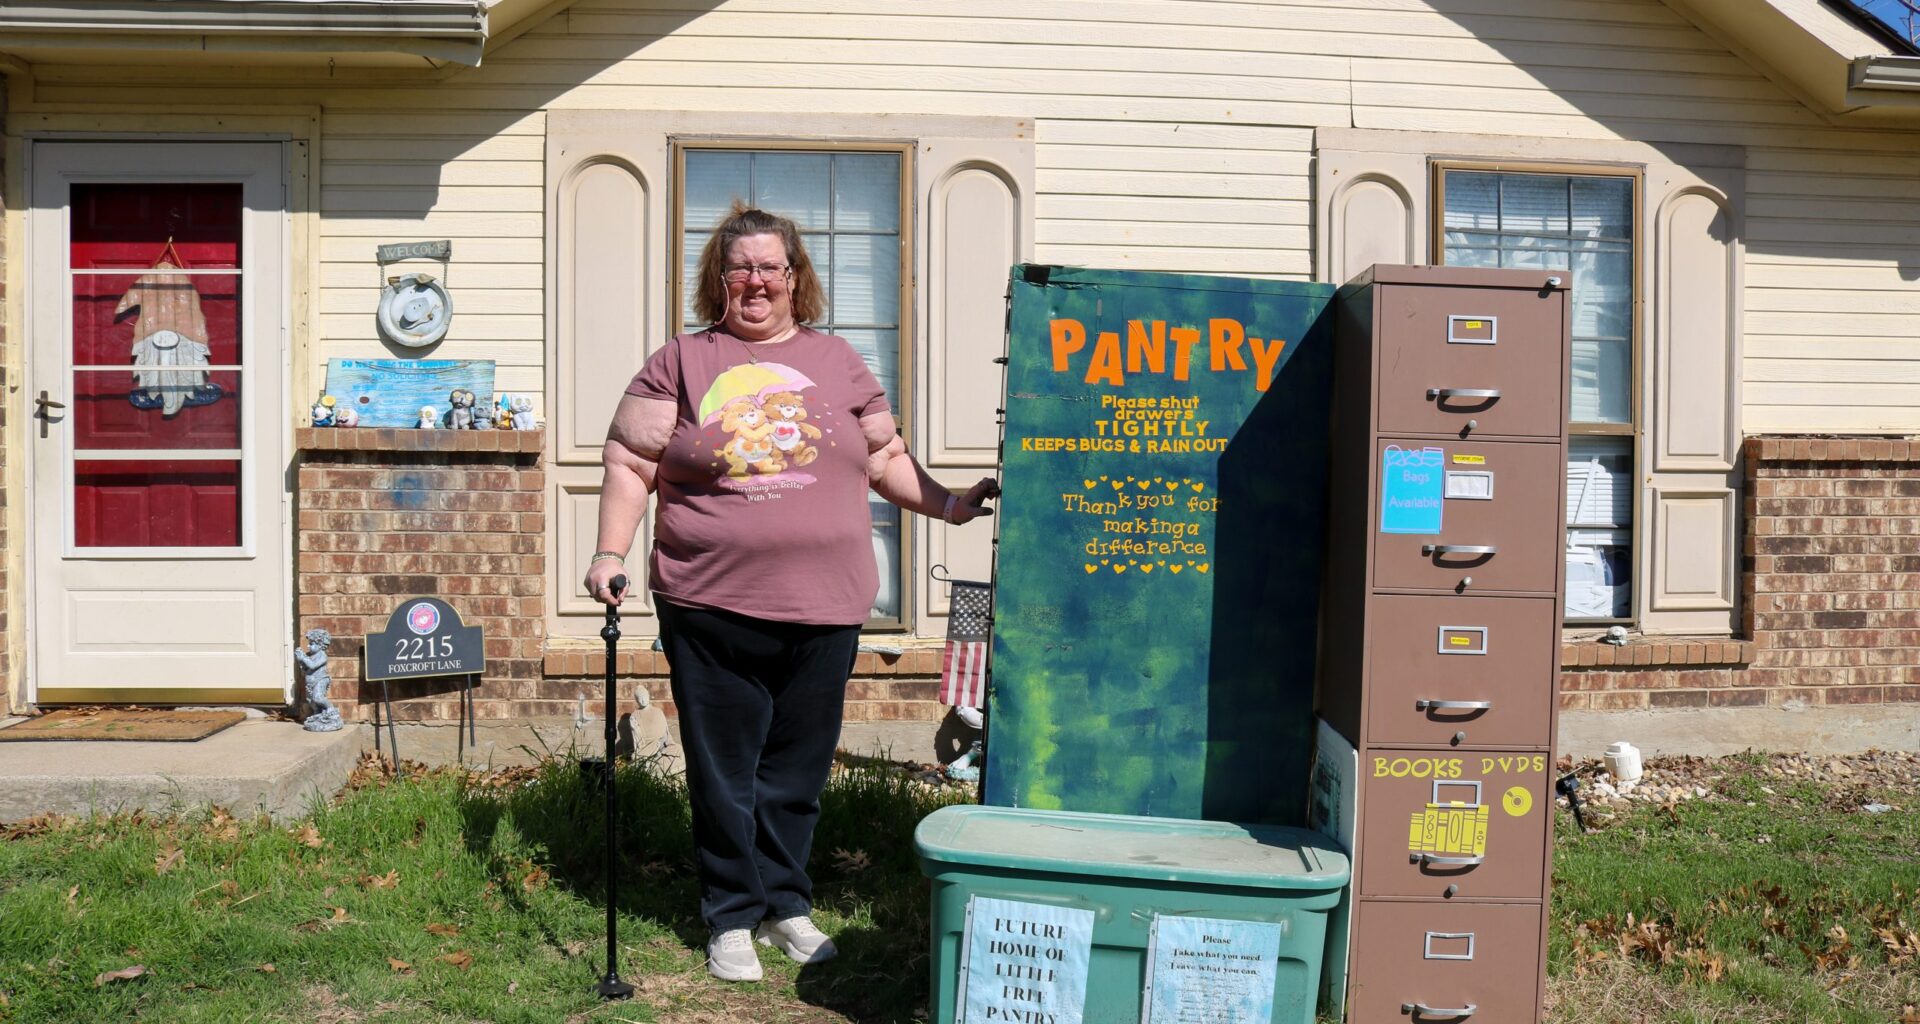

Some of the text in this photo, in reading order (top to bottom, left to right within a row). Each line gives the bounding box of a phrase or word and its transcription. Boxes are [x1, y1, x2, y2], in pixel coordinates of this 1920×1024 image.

[383, 243, 445, 258] WELCOME
[1050, 318, 1286, 393] PANTRY
[1101, 394, 1200, 409] Please shut
[1115, 404, 1195, 420] drawers
[1095, 420, 1209, 436] TIGHTLY
[1022, 438, 1228, 454] KEEPS BUGS & RAIN OUT
[780, 480, 804, 490] Better
[1402, 470, 1430, 485] Bags
[747, 492, 782, 502] With You
[1063, 492, 1222, 515] Thank you for
[1388, 496, 1439, 508] Available
[1085, 537, 1207, 556] difference
[395, 635, 454, 661] 2215
[388, 660, 462, 674] FOXCROFT LANE
[1373, 756, 1545, 778] BOOKS DVDS
[995, 918, 1069, 940] FUTURE
[1202, 935, 1232, 945] Please
[990, 940, 1069, 962] HOME OF
[1174, 948, 1195, 957] Take
[1197, 951, 1220, 959] what
[1222, 953, 1238, 961] you
[995, 962, 1059, 983] LITTLE
[1199, 964, 1221, 973] what
[1223, 967, 1239, 975] you
[1003, 985, 1048, 1005] FREE
[986, 1006, 1059, 1024] PANTRY
